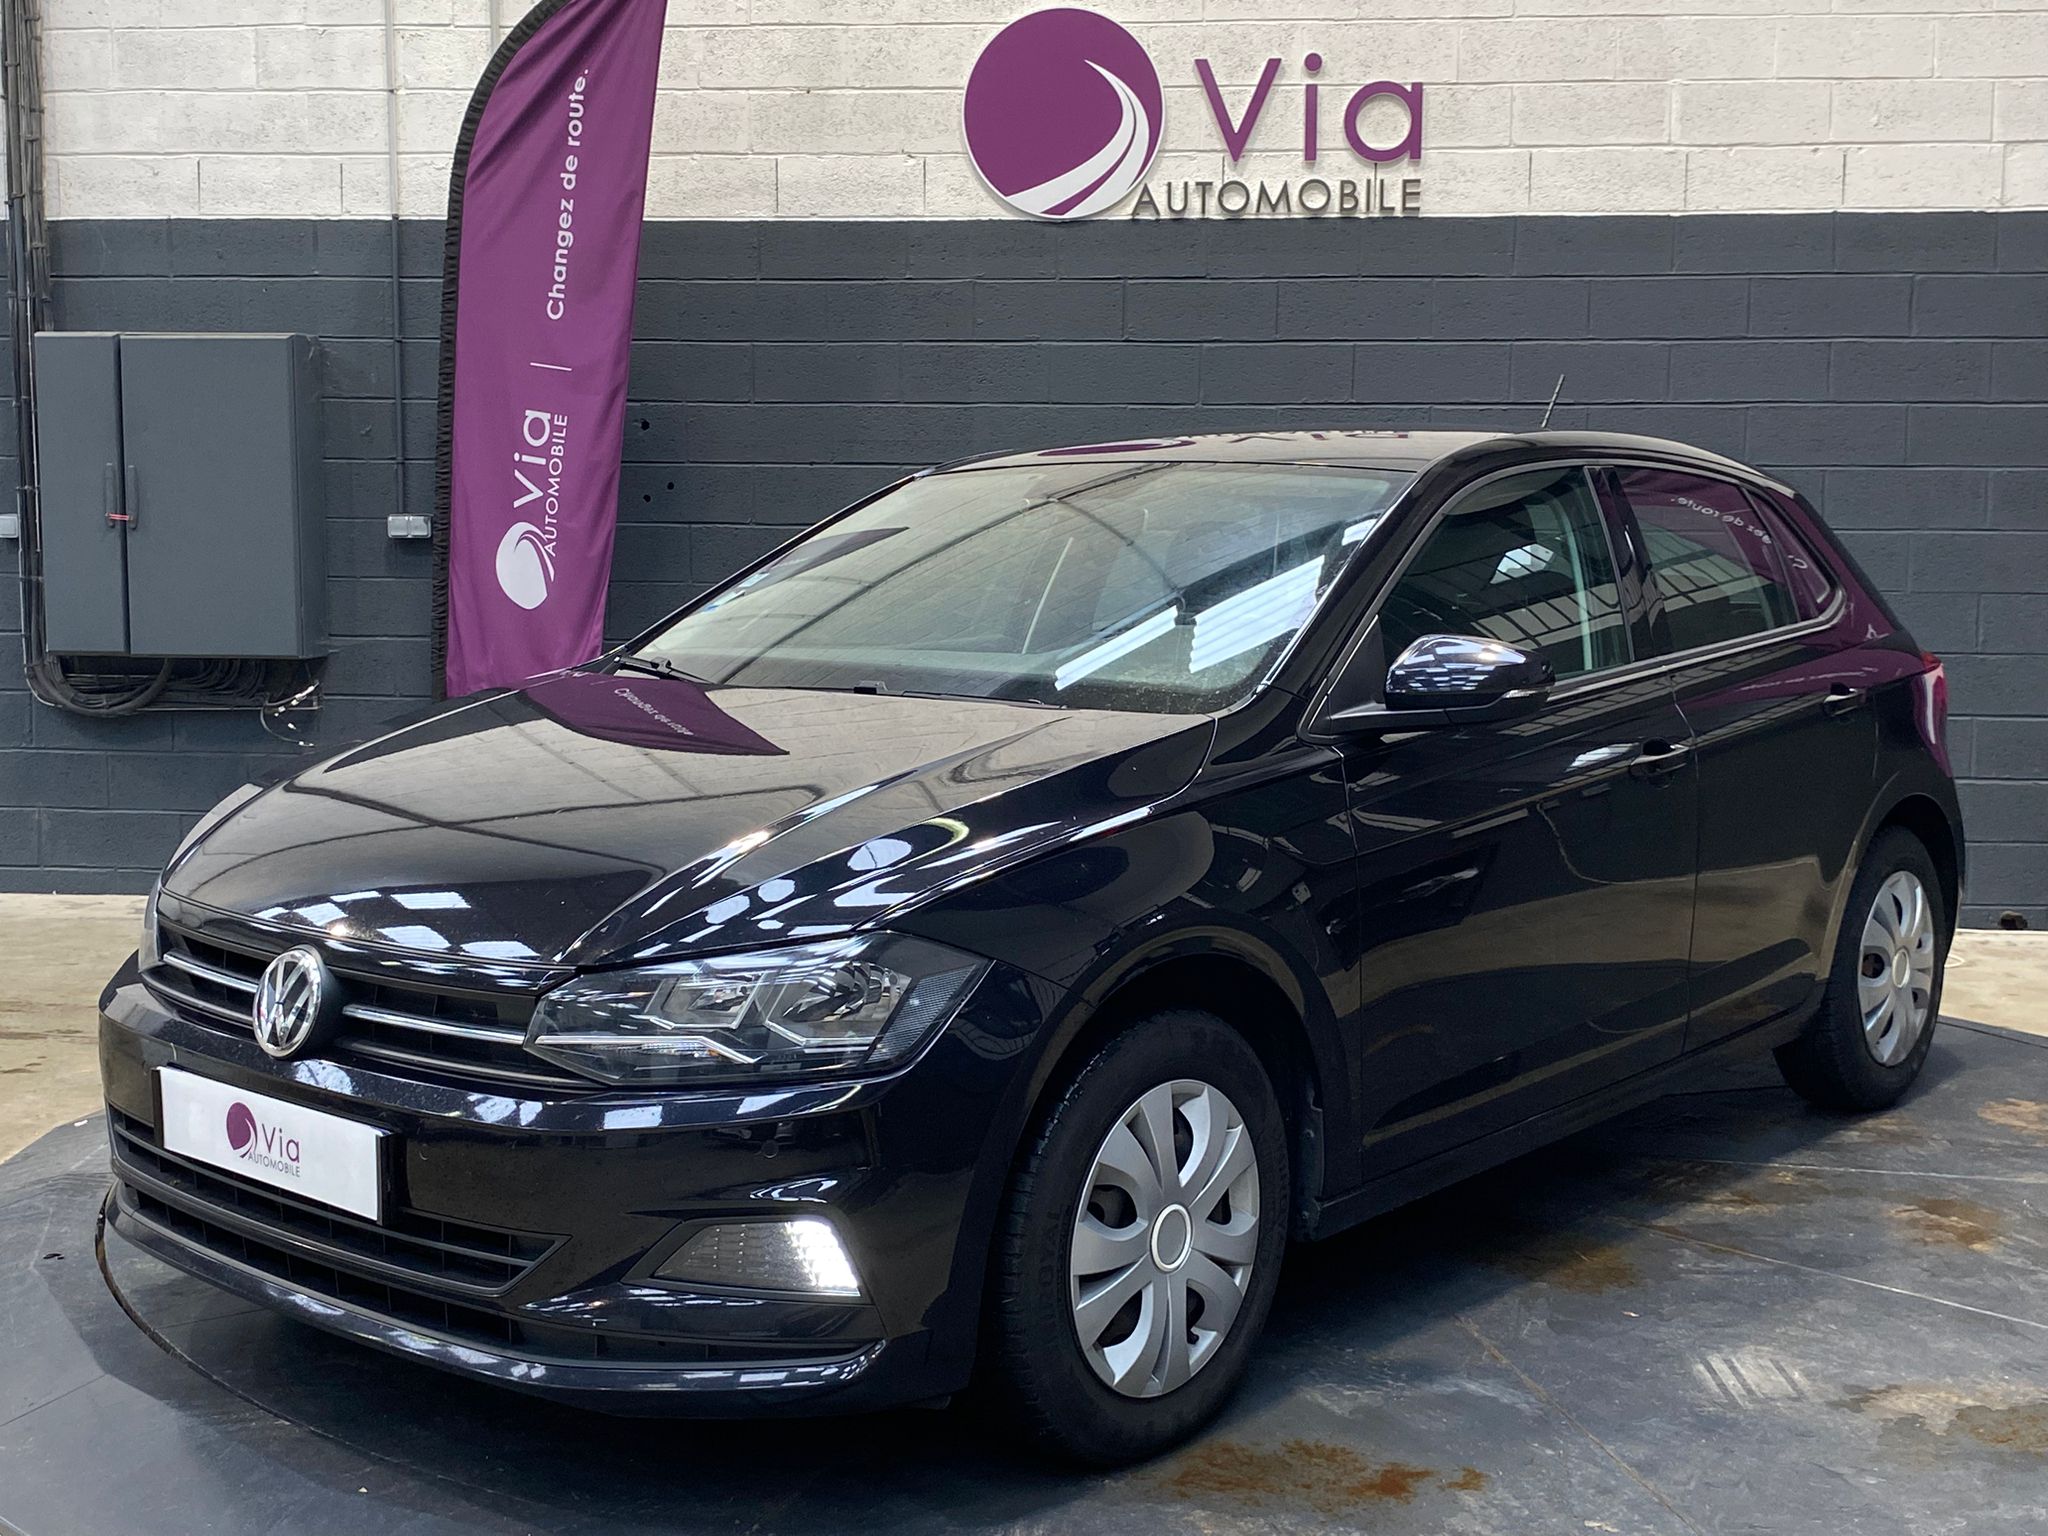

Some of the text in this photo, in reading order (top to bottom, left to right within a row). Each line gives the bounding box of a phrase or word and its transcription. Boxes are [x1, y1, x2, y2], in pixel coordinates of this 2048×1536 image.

[1194, 52, 1423, 163] Via
[546, 68, 589, 320] Changez de route.
[1133, 178, 1422, 217] AUTOMOBILE
[513, 409, 551, 508] Via
[543, 413, 568, 557] AUTOMOBILE
[248, 1151, 301, 1178] AUTOMOBILE
[261, 1122, 300, 1163] Via
